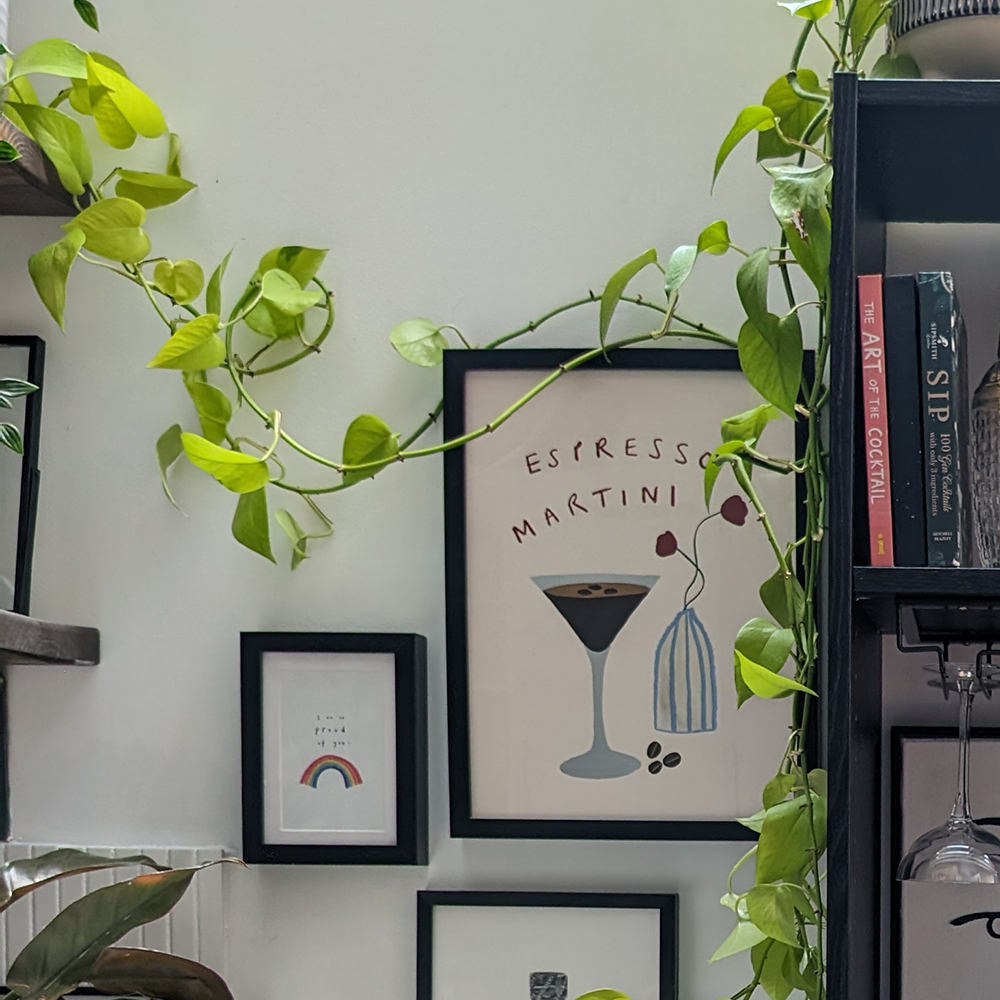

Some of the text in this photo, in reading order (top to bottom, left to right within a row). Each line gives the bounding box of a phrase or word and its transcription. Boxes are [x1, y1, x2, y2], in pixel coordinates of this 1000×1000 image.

[930, 322, 938, 360] SIPSMITH
[862, 301, 886, 505] THE ART OF THE COCKTAIL
[926, 370, 950, 422] SIP
[929, 450, 938, 467] only
[937, 433, 953, 513] 100 Gin Cocktails
[512, 485, 675, 544] MARTINI
[930, 473, 938, 517] ingredients
